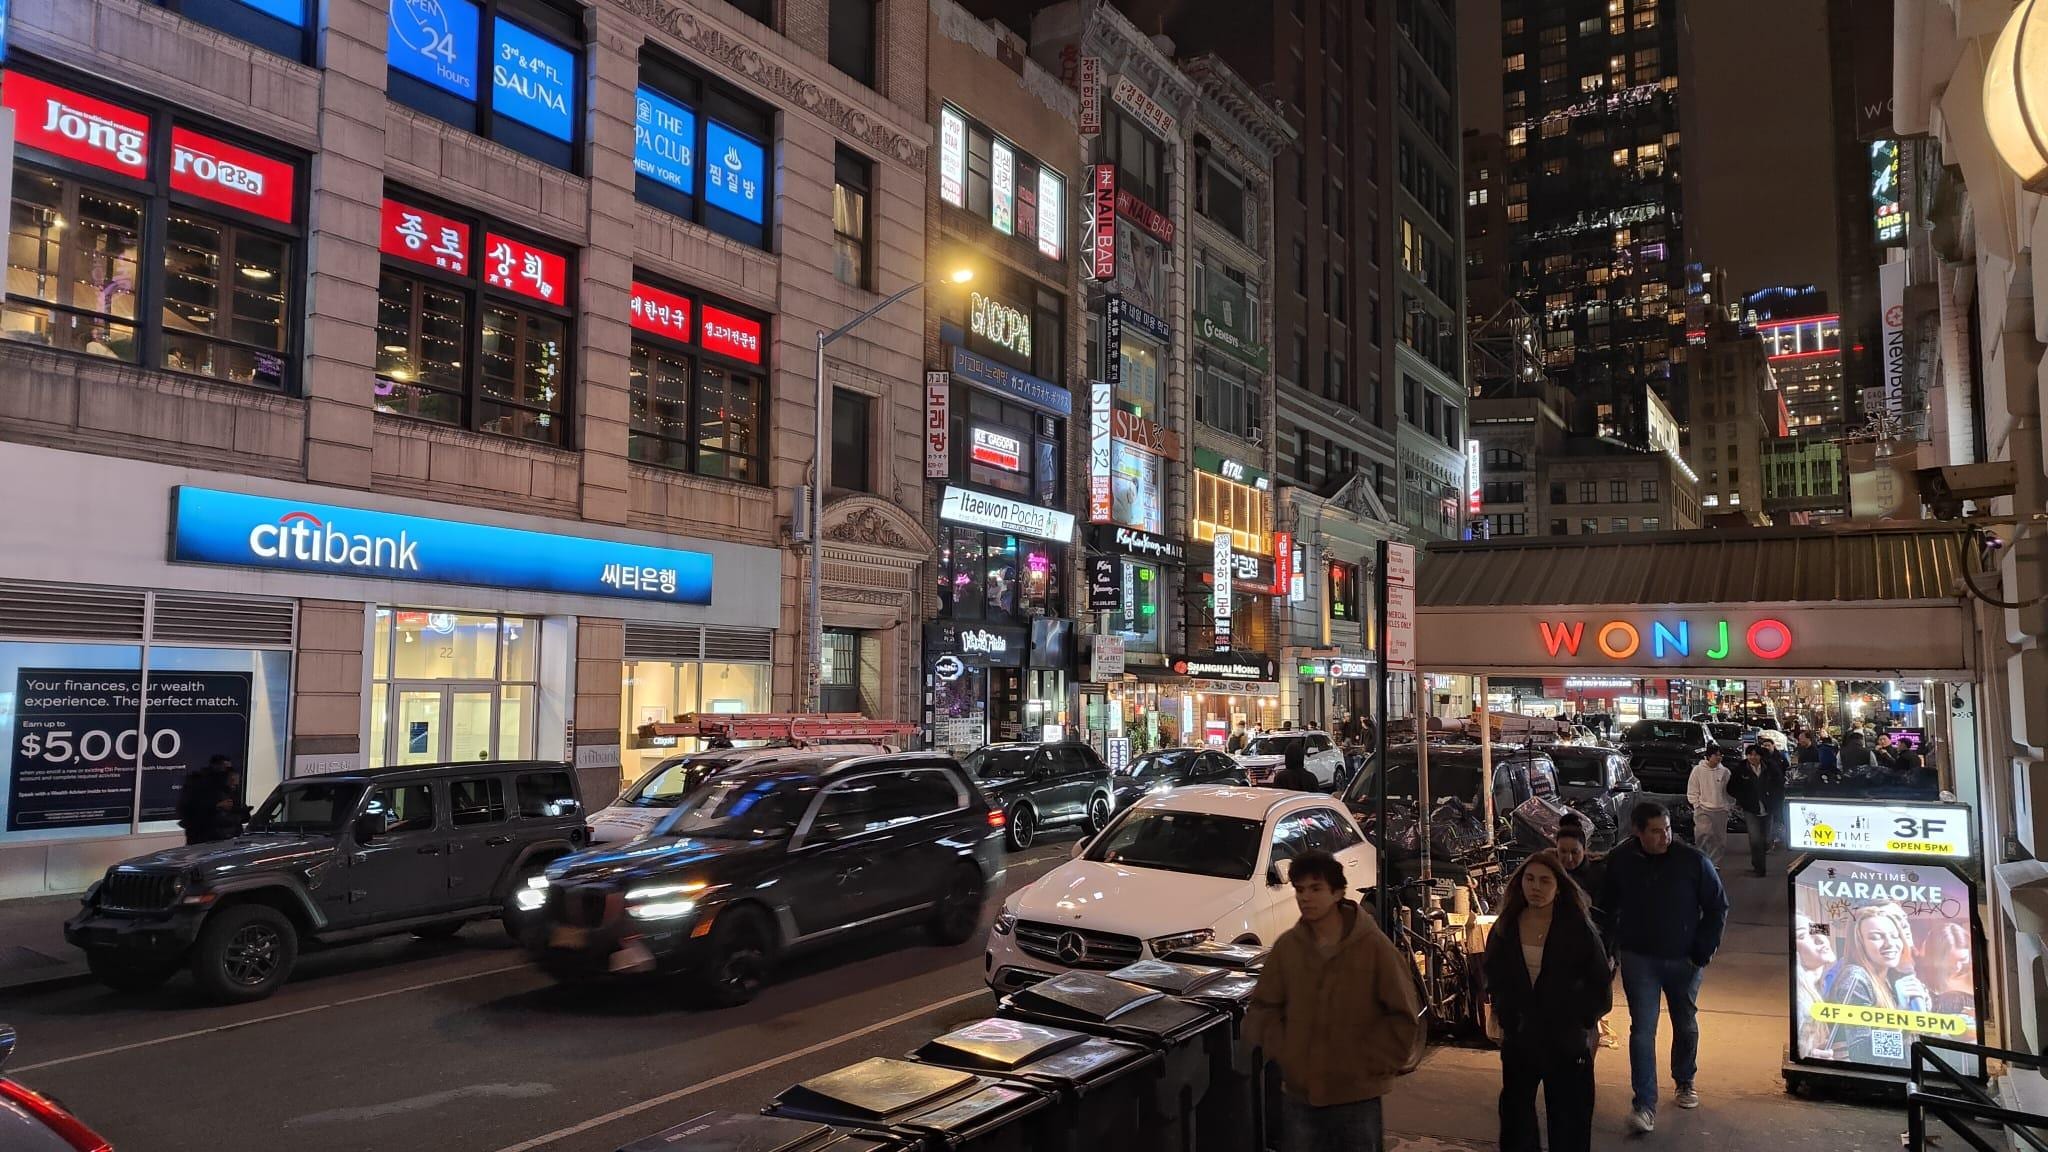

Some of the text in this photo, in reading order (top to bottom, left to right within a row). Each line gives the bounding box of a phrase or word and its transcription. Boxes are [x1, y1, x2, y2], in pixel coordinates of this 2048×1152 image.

[406, 0, 437, 16] PEN
[421, 27, 456, 64] 24
[437, 63, 470, 88] Hours
[501, 43, 563, 86] 3rd & 4th FL.
[494, 65, 567, 115] SAUNA
[43, 99, 142, 165] Jong
[655, 109, 683, 136] THE
[635, 124, 691, 166] PA CLUB
[635, 157, 681, 185] NEW YORK
[709, 164, 756, 200] 찜질방
[1128, 199, 1174, 242] NAIL BAR
[1877, 213, 1901, 229] HRS
[1878, 202, 1899, 216] 24
[395, 212, 464, 260] 종로
[1098, 189, 1112, 274] NAIL BAR
[1880, 225, 1902, 240] 5F
[631, 296, 685, 329] 대한민국
[971, 292, 1030, 357] GAGOPA
[929, 387, 945, 452] 노래방
[1092, 389, 1109, 439] SPA
[1116, 409, 1150, 448] SPA
[1093, 448, 1109, 473] 32
[960, 491, 1008, 520] Itaewon
[1010, 503, 1045, 527] Pocha
[1093, 502, 1108, 515] 3rd
[250, 514, 418, 572] citibank
[1165, 543, 1183, 558] HAIR
[599, 562, 677, 594] 씨티은행
[1215, 550, 1229, 615] 상하이몽
[1388, 610, 1408, 619] MERCIAL
[1540, 618, 1793, 660] WONJO
[439, 647, 453, 659] 22
[1187, 661, 1260, 674] SHANGHAI MONG
[27, 679, 61, 691] Your
[64, 679, 129, 693] finances,
[161, 680, 205, 692] wealth
[25, 695, 239, 709] experience. The perfect match.
[23, 720, 66, 729] Earn up to
[20, 729, 181, 765] $5,000
[1804, 829, 1871, 842] ANYTIME
[1893, 817, 1947, 839] 3F
[1803, 840, 1846, 848] KITCHEN
[1892, 841, 1948, 852] OPEN 5PM
[1850, 871, 1907, 882] ANYTIME
[1818, 880, 1943, 904] KARAOKE
[1820, 1006, 1956, 1031] 4F OPEN 5PM
